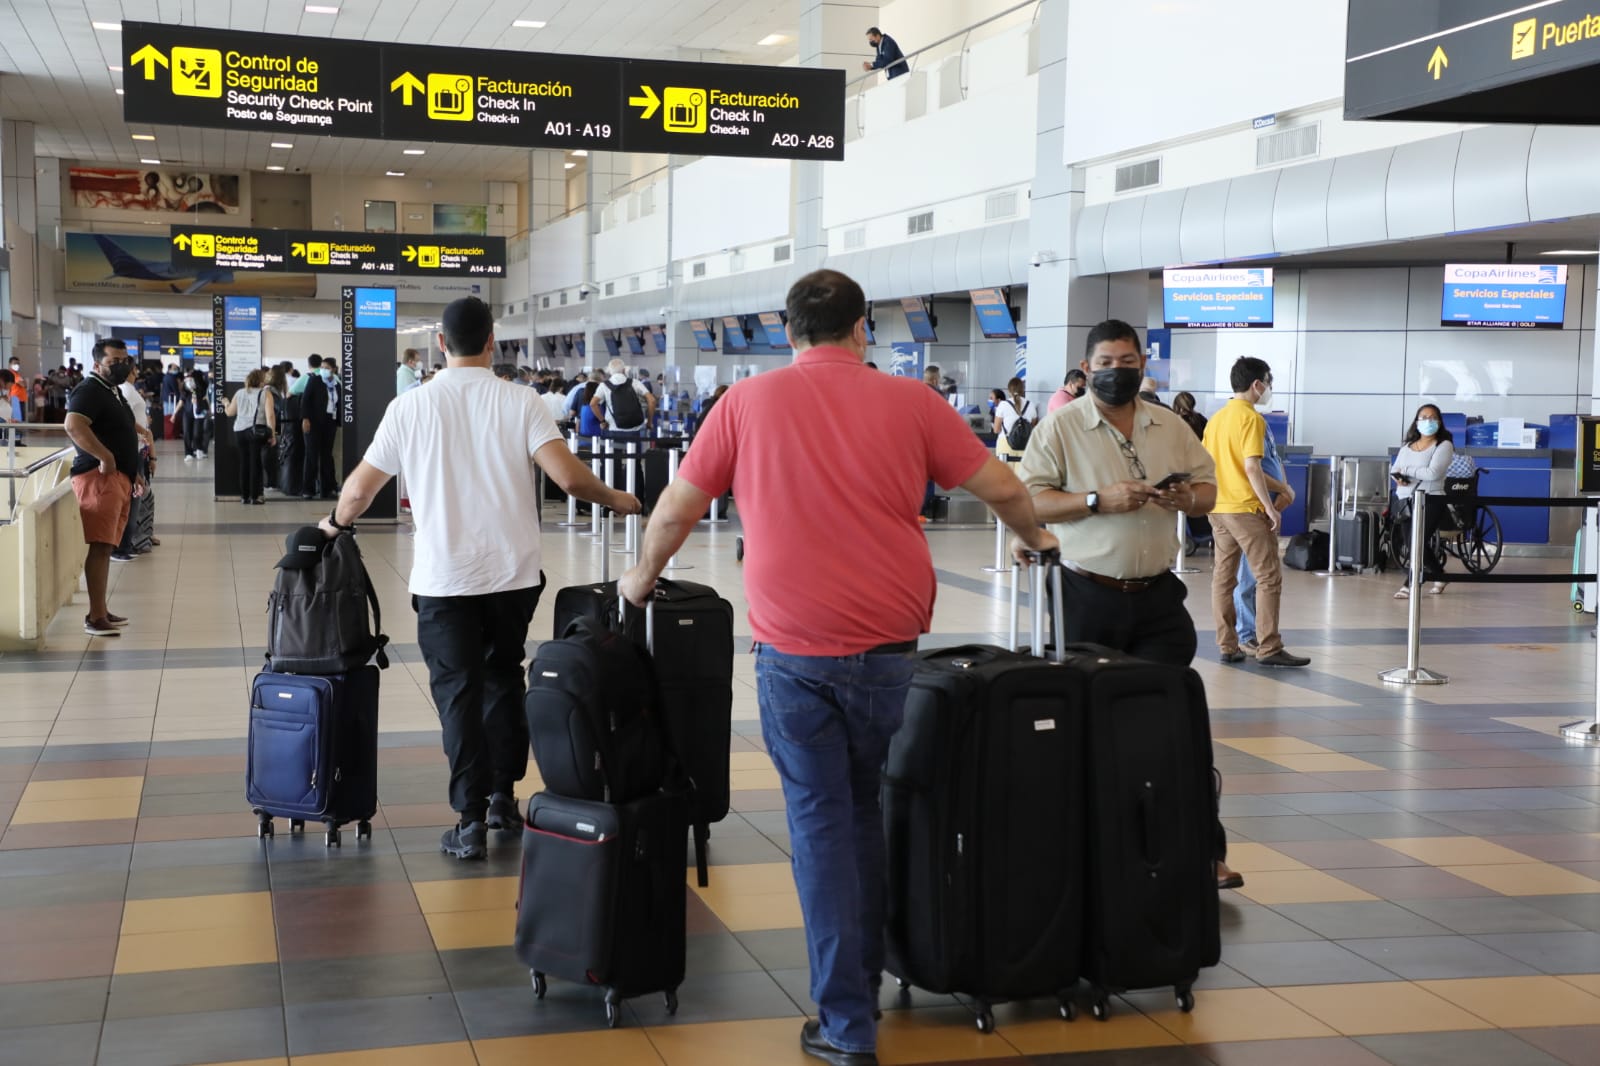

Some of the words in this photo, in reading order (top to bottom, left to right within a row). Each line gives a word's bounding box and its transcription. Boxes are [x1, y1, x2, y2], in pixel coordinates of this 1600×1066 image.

[226, 51, 290, 72] Control
[296, 57, 318, 74] de
[226, 70, 318, 92] Seguridad
[477, 76, 572, 97] Facturación
[227, 90, 285, 110] Security
[289, 94, 334, 110] Check
[338, 98, 373, 113] Point
[478, 96, 520, 110] Check
[524, 98, 535, 111] In
[710, 90, 799, 108] Facturación
[227, 107, 257, 119] Posto
[260, 110, 273, 120] de
[276, 111, 333, 126] Segurança
[477, 112, 519, 124] Check-in
[710, 108, 750, 122] Check
[753, 110, 764, 123] In
[544, 121, 572, 136] A01
[582, 123, 611, 138] A19
[710, 124, 749, 135] Check-in
[771, 133, 799, 147] A20
[807, 134, 834, 149] A26
[216, 236, 245, 245] Control
[247, 237, 258, 245] de
[330, 243, 376, 252] Facturación
[216, 244, 258, 254] Seguridad
[441, 247, 484, 256] Facturación
[1172, 273, 1246, 283] CopaAirlines
[1454, 268, 1536, 278] CopaAirlines
[1172, 292, 1214, 301] Servicios
[1216, 291, 1264, 302] Especiales
[1453, 289, 1499, 298] Servicios
[1501, 289, 1555, 300] Especiales
[215, 307, 223, 335] GOLD
[344, 301, 353, 333] GOLD
[344, 336, 353, 393] ALLIANCE
[216, 390, 224, 414] STAR
[345, 395, 353, 423] STAR
